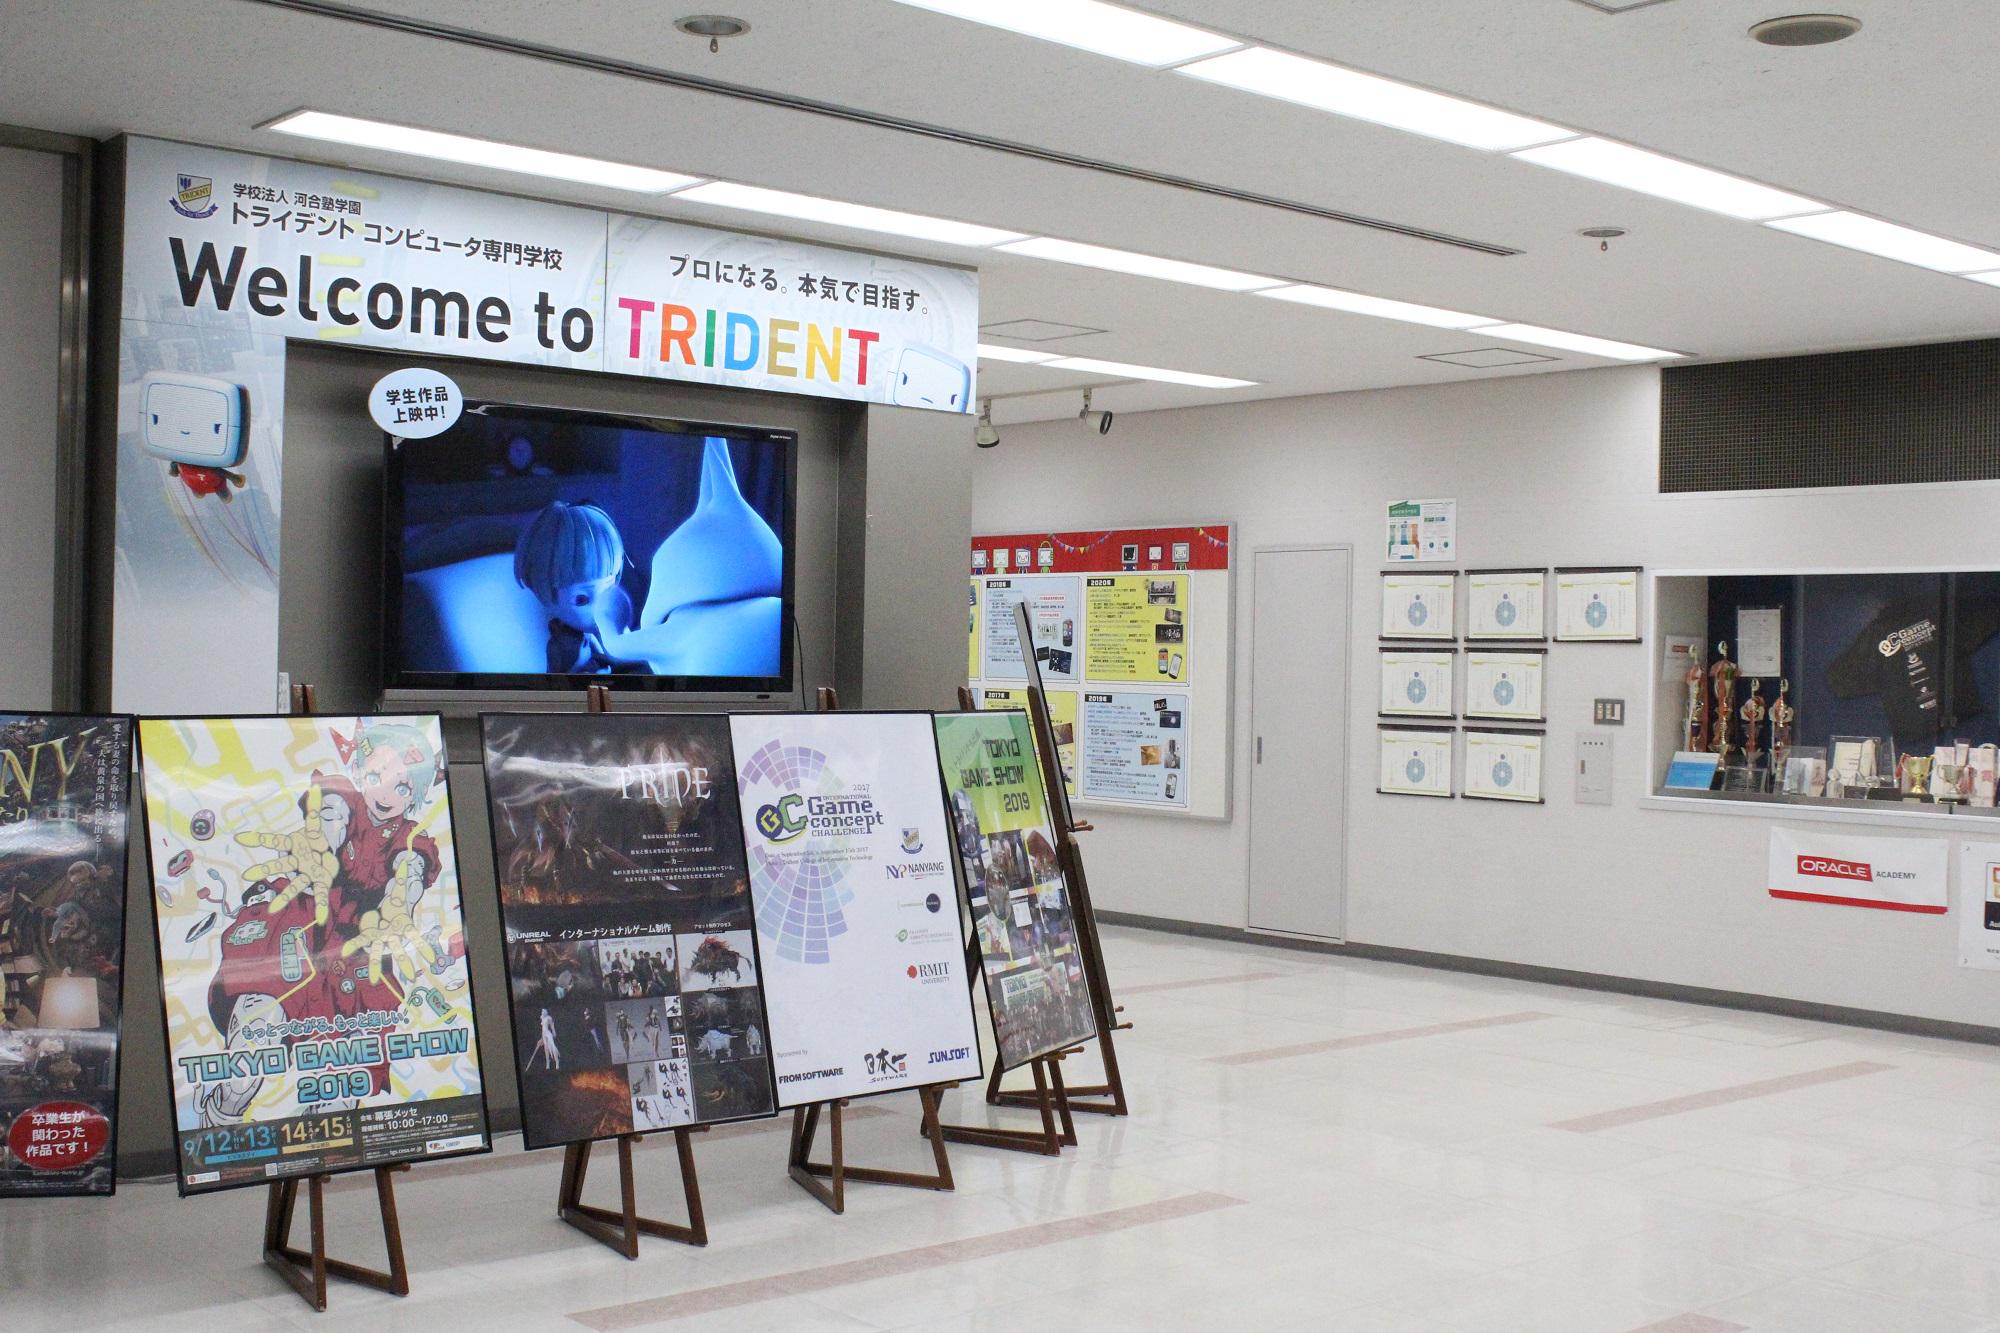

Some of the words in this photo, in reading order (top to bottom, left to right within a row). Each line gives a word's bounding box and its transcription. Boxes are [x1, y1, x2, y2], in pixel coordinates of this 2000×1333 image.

[233, 183, 288, 205] 学校法人
[294, 191, 361, 216] 河合塾学園
[232, 201, 354, 240] トライデント
[364, 222, 563, 271] コンピュータ専門学校
[670, 253, 928, 315] プロになる。本気で目指す。
[169, 236, 511, 344] Welcome
[535, 292, 594, 353] to
[618, 297, 880, 386] TRIDENT
[386, 386, 449, 406] 学生作品
[982, 738, 1021, 758] TOKYO
[621, 764, 712, 807] PRIDE
[960, 768, 992, 788] GAME
[993, 765, 1025, 786] SHOW
[808, 796, 873, 816] Game
[1004, 792, 1030, 812] 2019
[810, 811, 884, 834] concept
[811, 827, 866, 837] CHALLENGE
[908, 861, 944, 873] NANYANG
[1800, 859, 1868, 878] ORACLE
[1875, 870, 1917, 880] ACADEMY
[516, 931, 551, 939] UNREAL
[559, 923, 672, 939] インターナショナルゲーム制作
[919, 962, 949, 977] RMIT
[179, 1047, 288, 1083] TOKYO
[295, 1037, 381, 1071] GAME
[389, 1028, 468, 1060] SHOW
[297, 1071, 371, 1103] 2019
[32, 1110, 86, 1125] 卒業生が
[32, 1126, 86, 1141] 関わった
[281, 1122, 307, 1143] 14
[320, 1117, 344, 1138] 15
